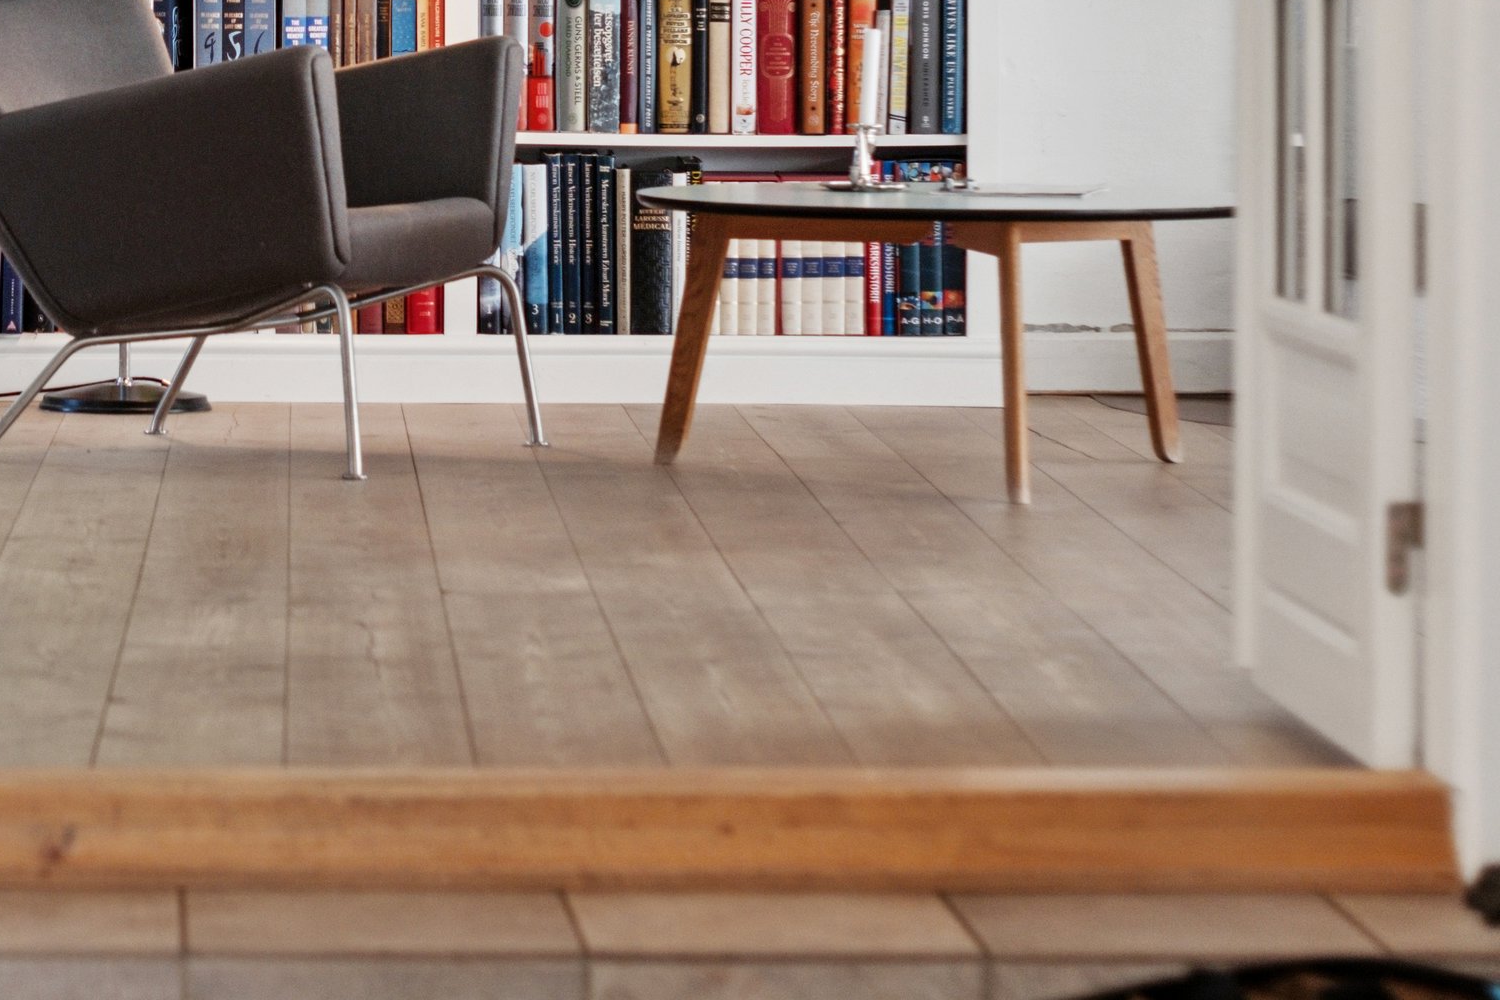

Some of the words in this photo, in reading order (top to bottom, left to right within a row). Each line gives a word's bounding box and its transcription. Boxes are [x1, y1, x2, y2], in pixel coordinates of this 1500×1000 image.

[626, 20, 634, 46] DANSK
[809, 12, 821, 29] The
[204, 32, 216, 64] 4
[227, 31, 241, 62] 5
[740, 28, 752, 76] COOPER
[809, 31, 821, 77] Neverending
[946, 33, 956, 58] LIKE
[592, 30, 603, 87] besættelsen
[626, 48, 634, 75] KUNST
[946, 61, 956, 74] US
[809, 80, 821, 101] Story
[946, 77, 956, 95] PLUM
[946, 97, 956, 118] SYKES
[552, 162, 560, 184] Janson
[568, 162, 576, 184] Janson
[600, 179, 610, 214] Mennesket
[552, 186, 560, 237] Verdenskunstens
[568, 186, 576, 237] Verdenskunstens
[600, 215, 610, 223] og
[552, 239, 560, 264] Historie
[568, 239, 576, 264] Historie
[600, 224, 610, 258] kunstneren
[600, 259, 610, 282] Edvard
[600, 285, 610, 306] Munch
[531, 304, 540, 315] 3
